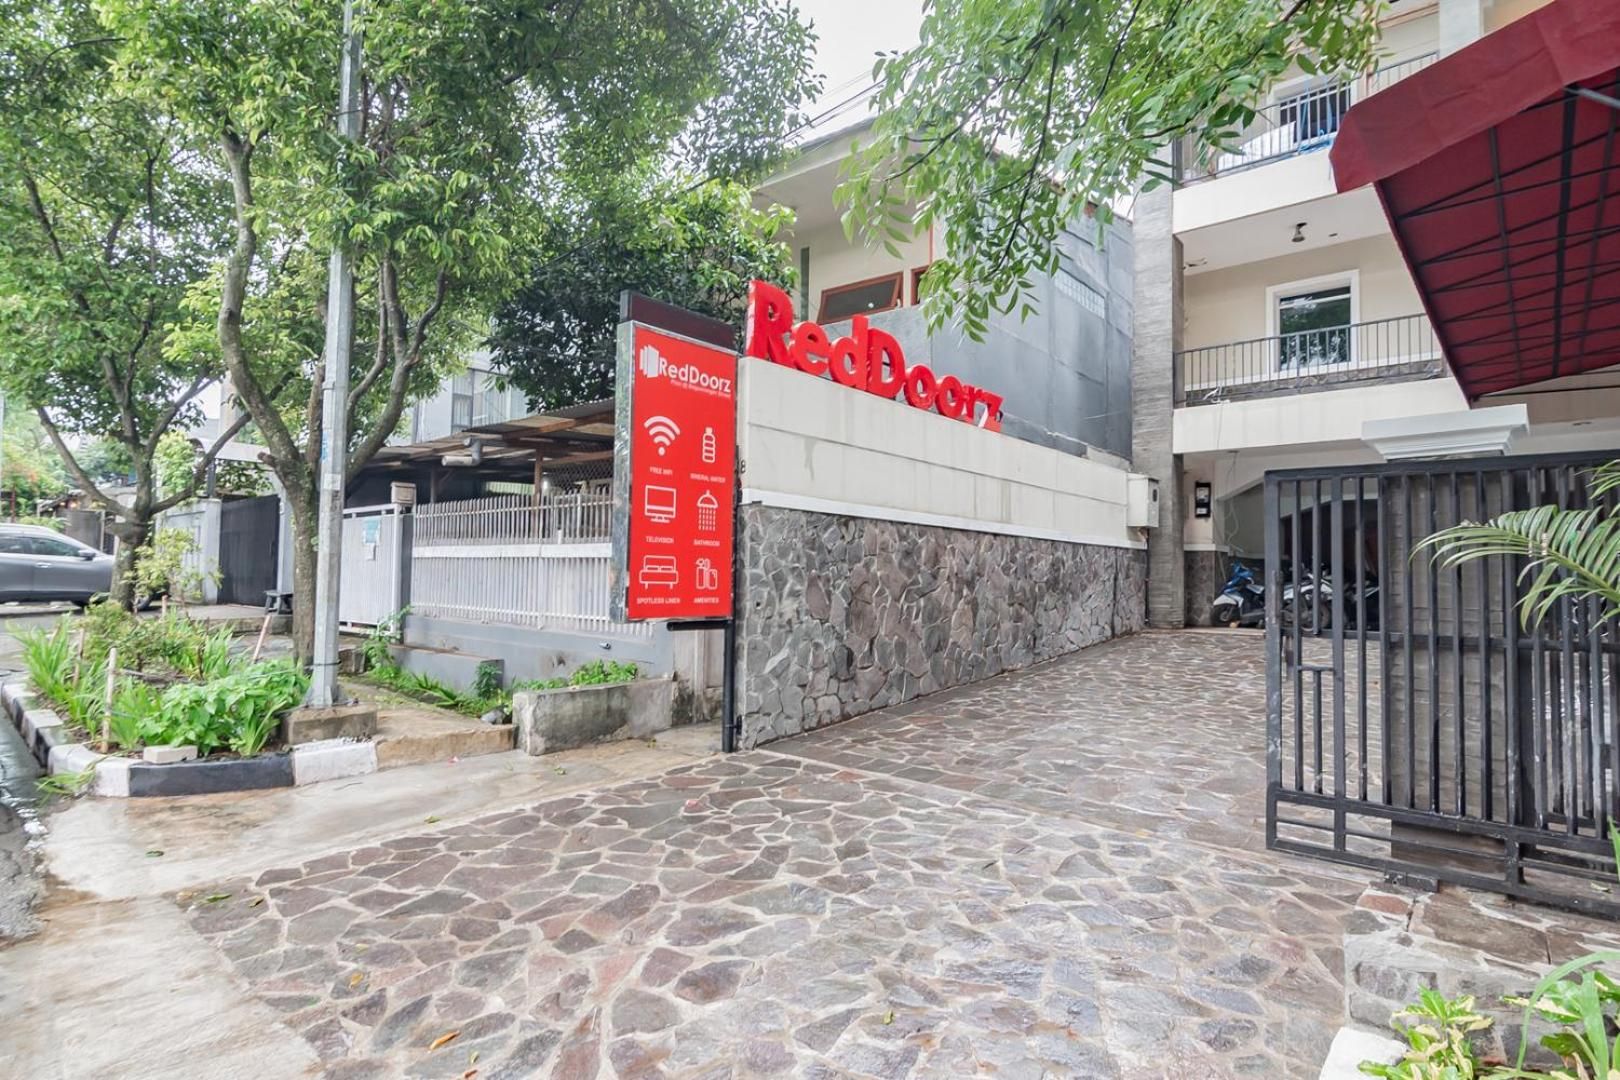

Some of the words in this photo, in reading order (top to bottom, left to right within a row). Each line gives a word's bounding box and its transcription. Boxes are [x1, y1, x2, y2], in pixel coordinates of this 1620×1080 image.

[747, 280, 1004, 433] RedDoorz
[659, 357, 731, 393] RedDoorz
[646, 535, 674, 544] TELEVISION
